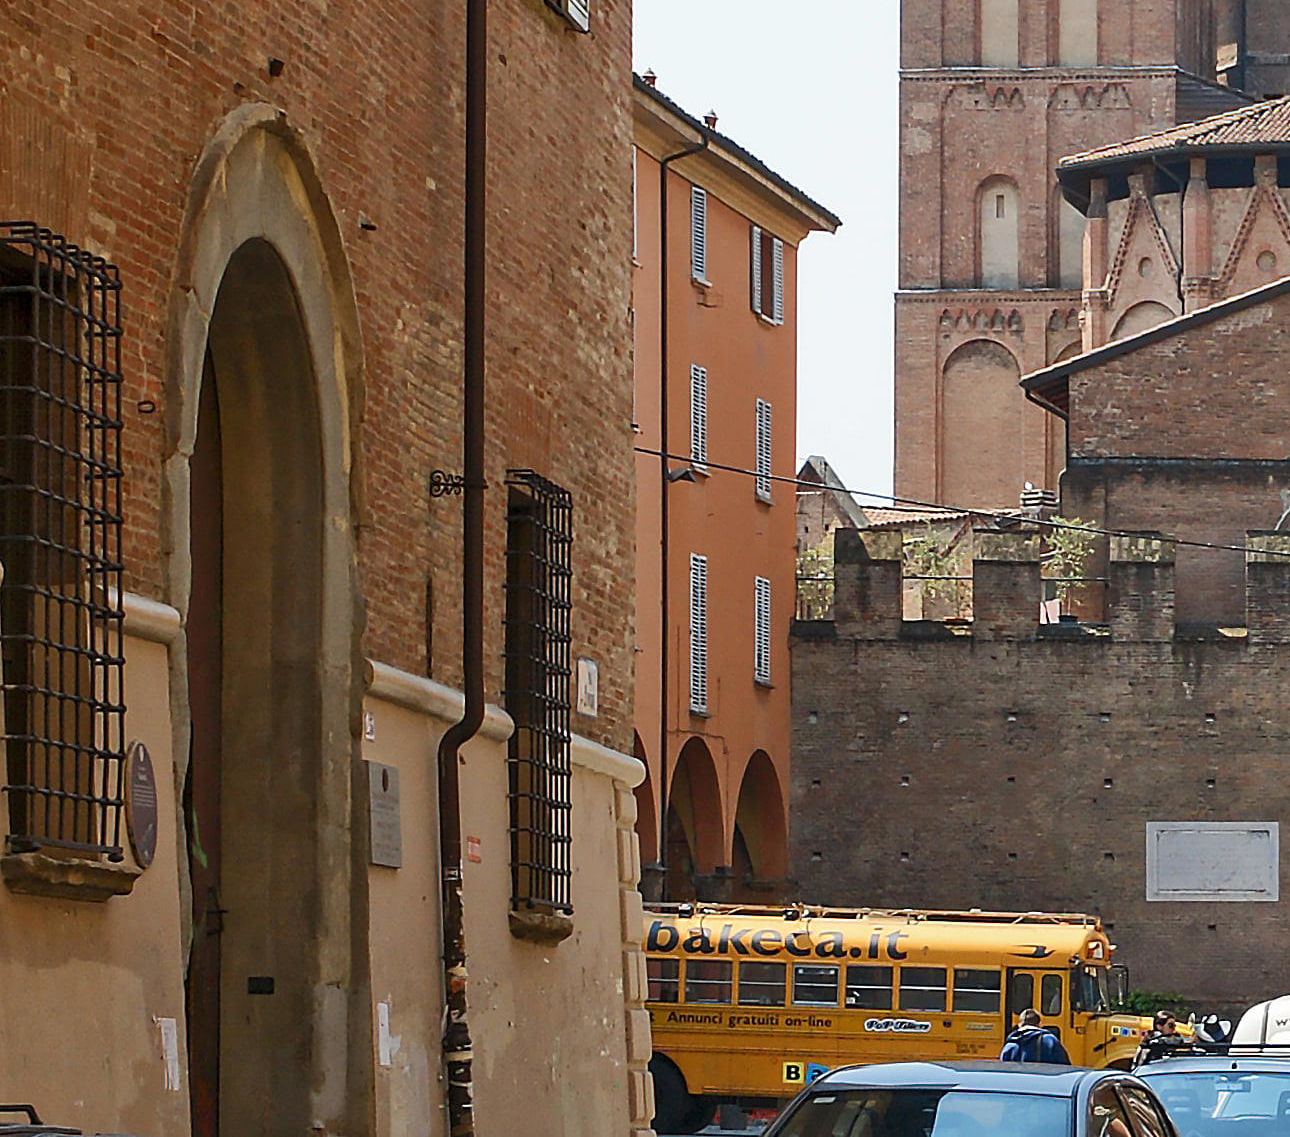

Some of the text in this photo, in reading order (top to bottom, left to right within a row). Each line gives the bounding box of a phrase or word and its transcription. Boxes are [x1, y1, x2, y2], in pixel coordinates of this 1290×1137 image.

[646, 920, 910, 961] bakeca.it
[666, 1011, 723, 1025] Annunci
[728, 1014, 780, 1028] gratuiti
[784, 1015, 833, 1028] on-line
